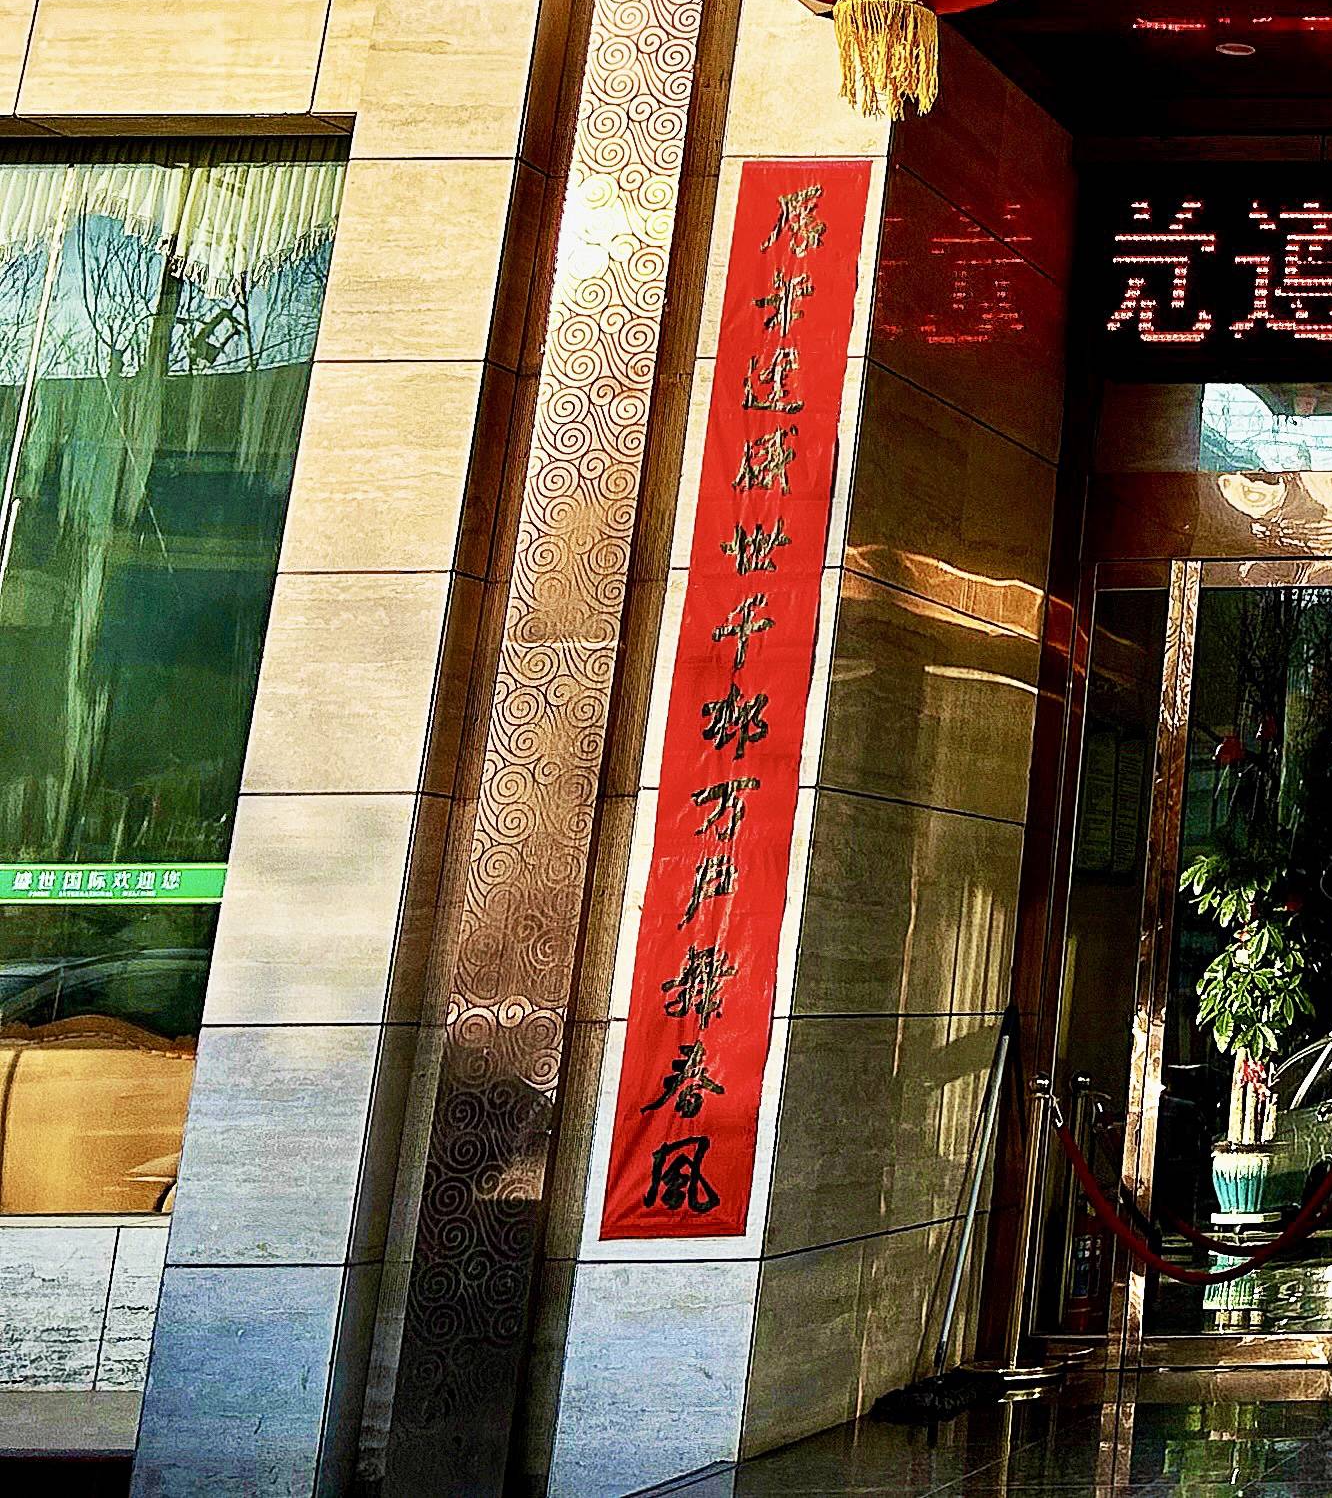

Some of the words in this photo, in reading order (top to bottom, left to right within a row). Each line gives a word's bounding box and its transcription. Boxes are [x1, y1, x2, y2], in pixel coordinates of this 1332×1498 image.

[12, 870, 182, 891] 盛世国际欢迎您
